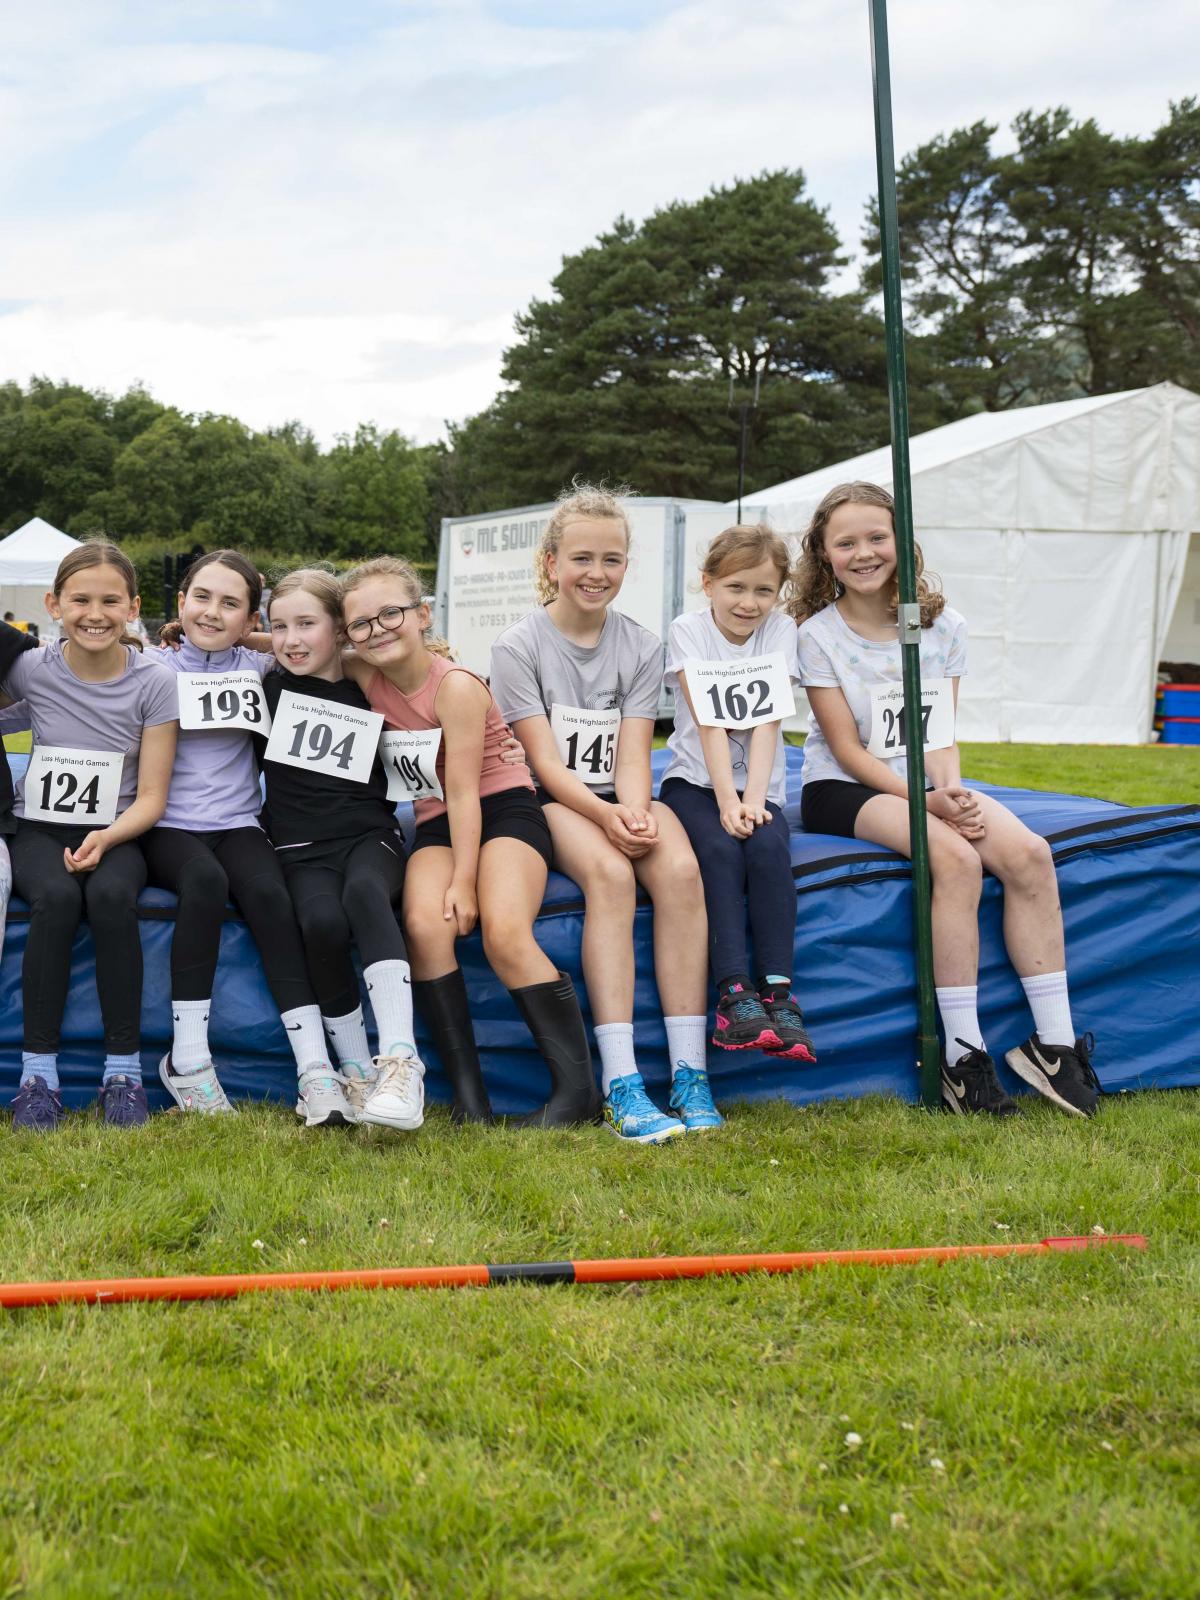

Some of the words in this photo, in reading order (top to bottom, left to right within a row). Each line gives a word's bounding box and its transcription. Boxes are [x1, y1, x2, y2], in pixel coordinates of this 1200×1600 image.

[477, 527, 497, 553] MC
[210, 677, 242, 686] Highland
[715, 669, 745, 677] Highland
[747, 664, 773, 674] Games
[198, 689, 262, 723] 193
[292, 702, 309, 712] Luss
[311, 707, 342, 719] Highland
[344, 716, 368, 727] Games
[707, 680, 773, 721] 162
[563, 715, 578, 723] Luss
[580, 716, 608, 727] Highland
[288, 720, 356, 770] 194
[566, 731, 615, 773] 145
[55, 757, 84, 766] Highland
[393, 754, 434, 791] 191
[40, 771, 100, 814] 124
